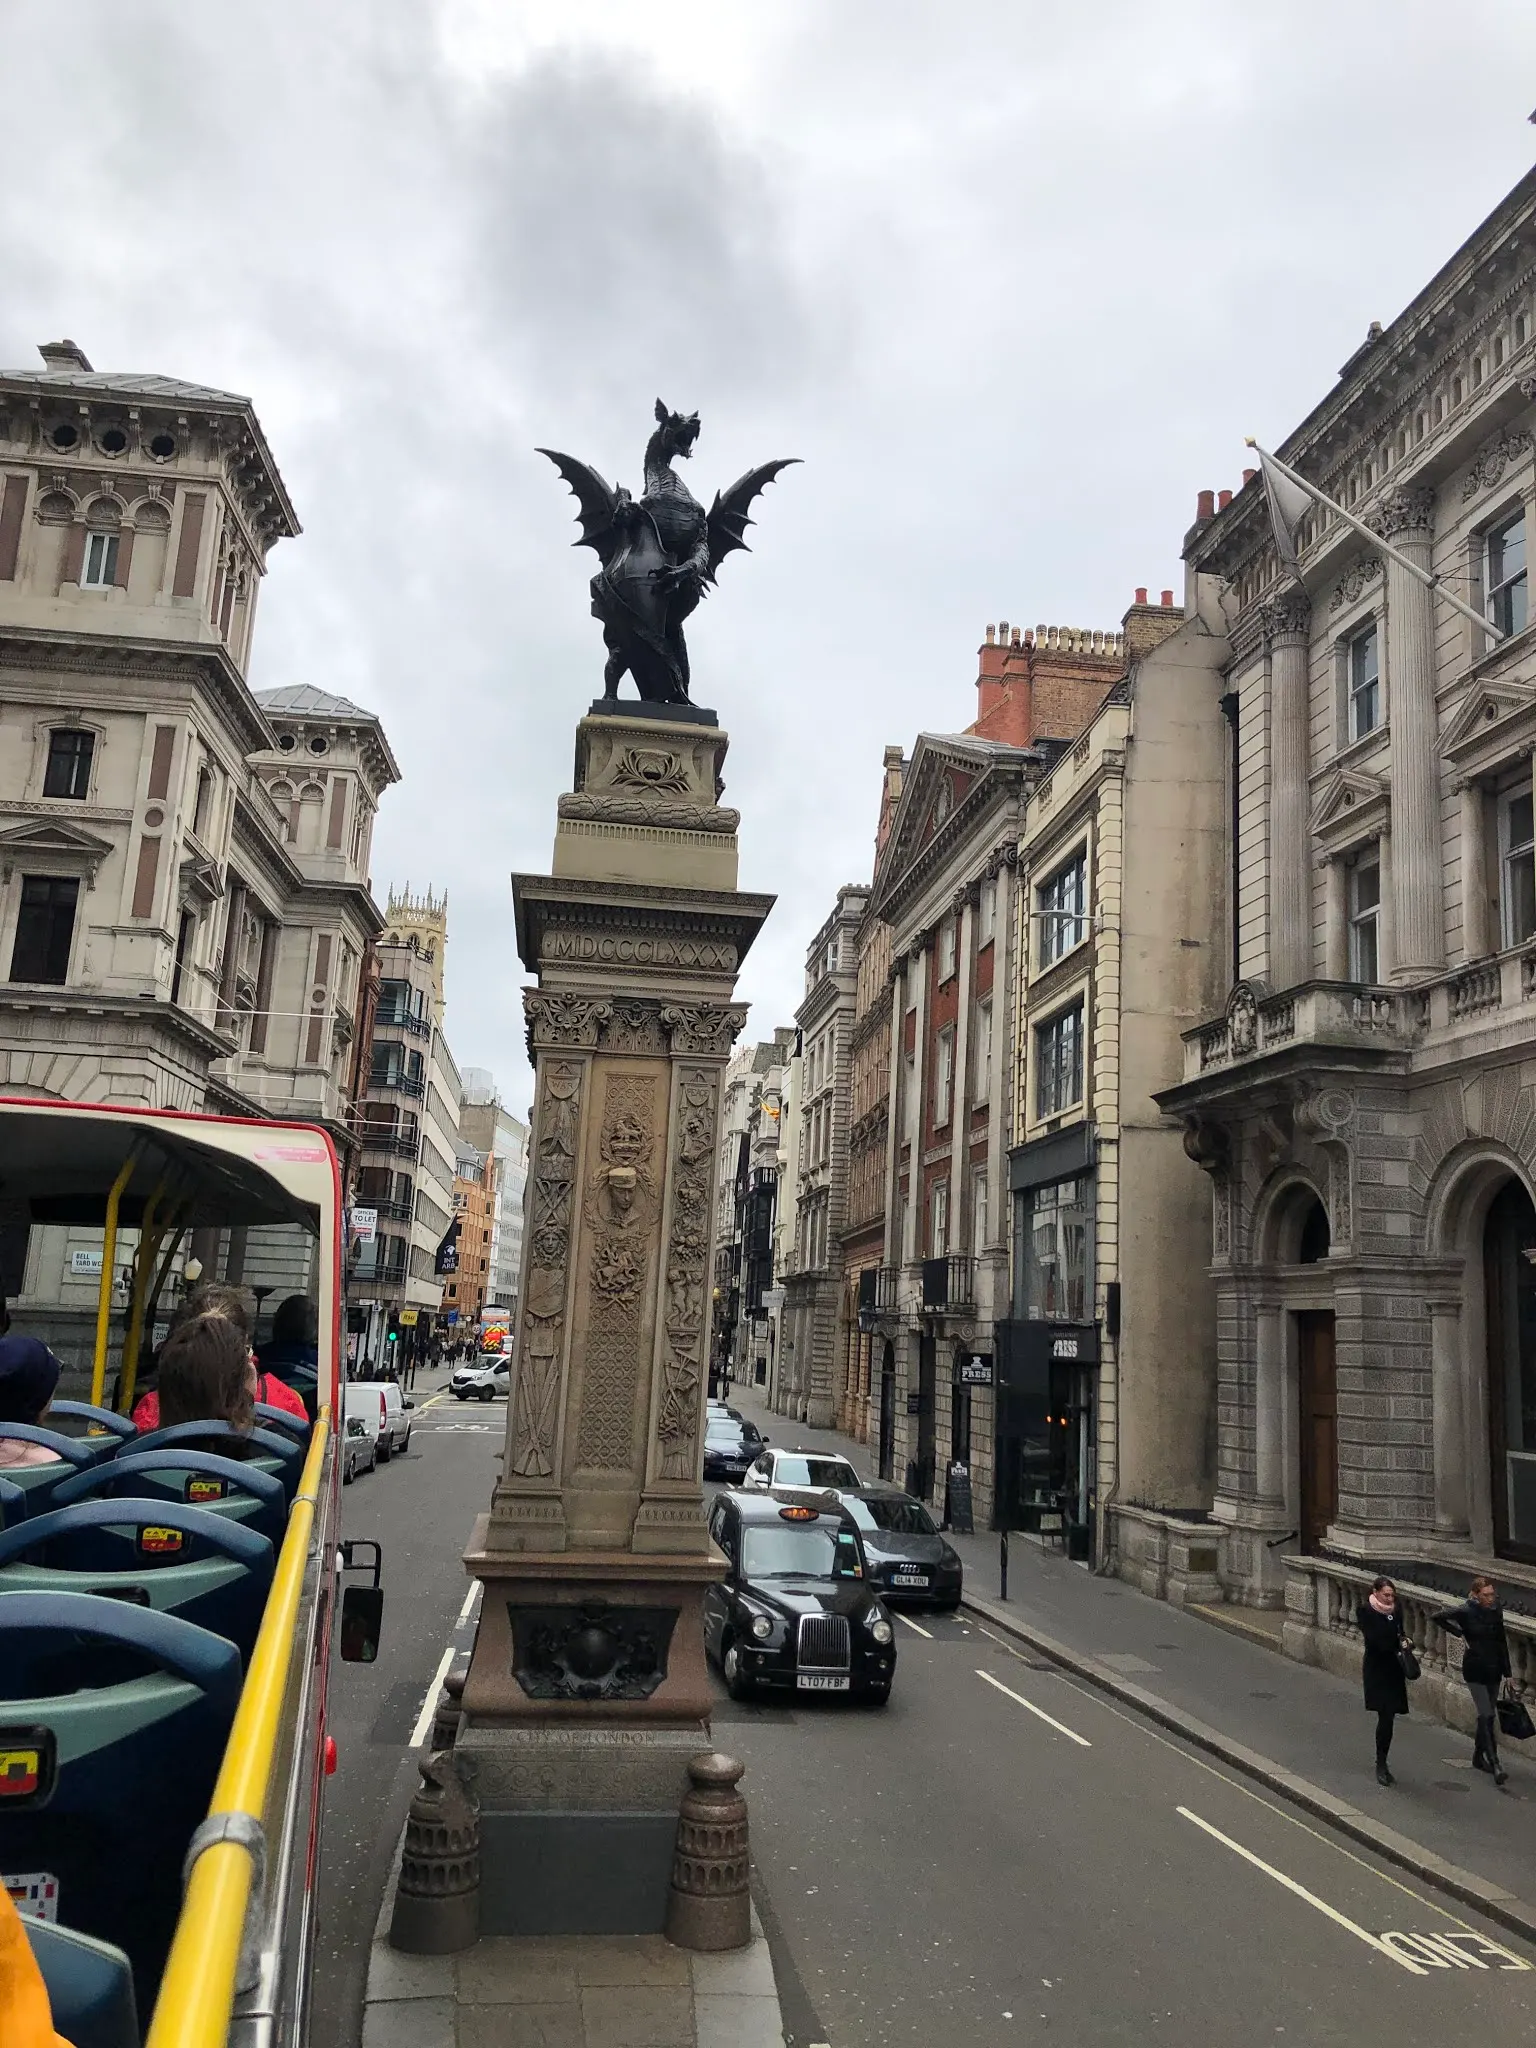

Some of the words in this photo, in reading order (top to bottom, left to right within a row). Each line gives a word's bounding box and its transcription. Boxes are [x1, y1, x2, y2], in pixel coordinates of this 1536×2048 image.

[554, 933, 728, 968] MDCCCLXXX
[552, 1080, 574, 1090] WAR
[687, 1088, 709, 1098] PEACE
[1053, 1340, 1078, 1358] PRESS
[961, 1370, 992, 1379] PRESS
[896, 1575, 912, 1584] GL14
[800, 1676, 826, 1688] LT07
[827, 1677, 847, 1688] FBF
[517, 1730, 550, 1744] CITY
[558, 1731, 582, 1745] OF
[587, 1732, 656, 1746] LONDON
